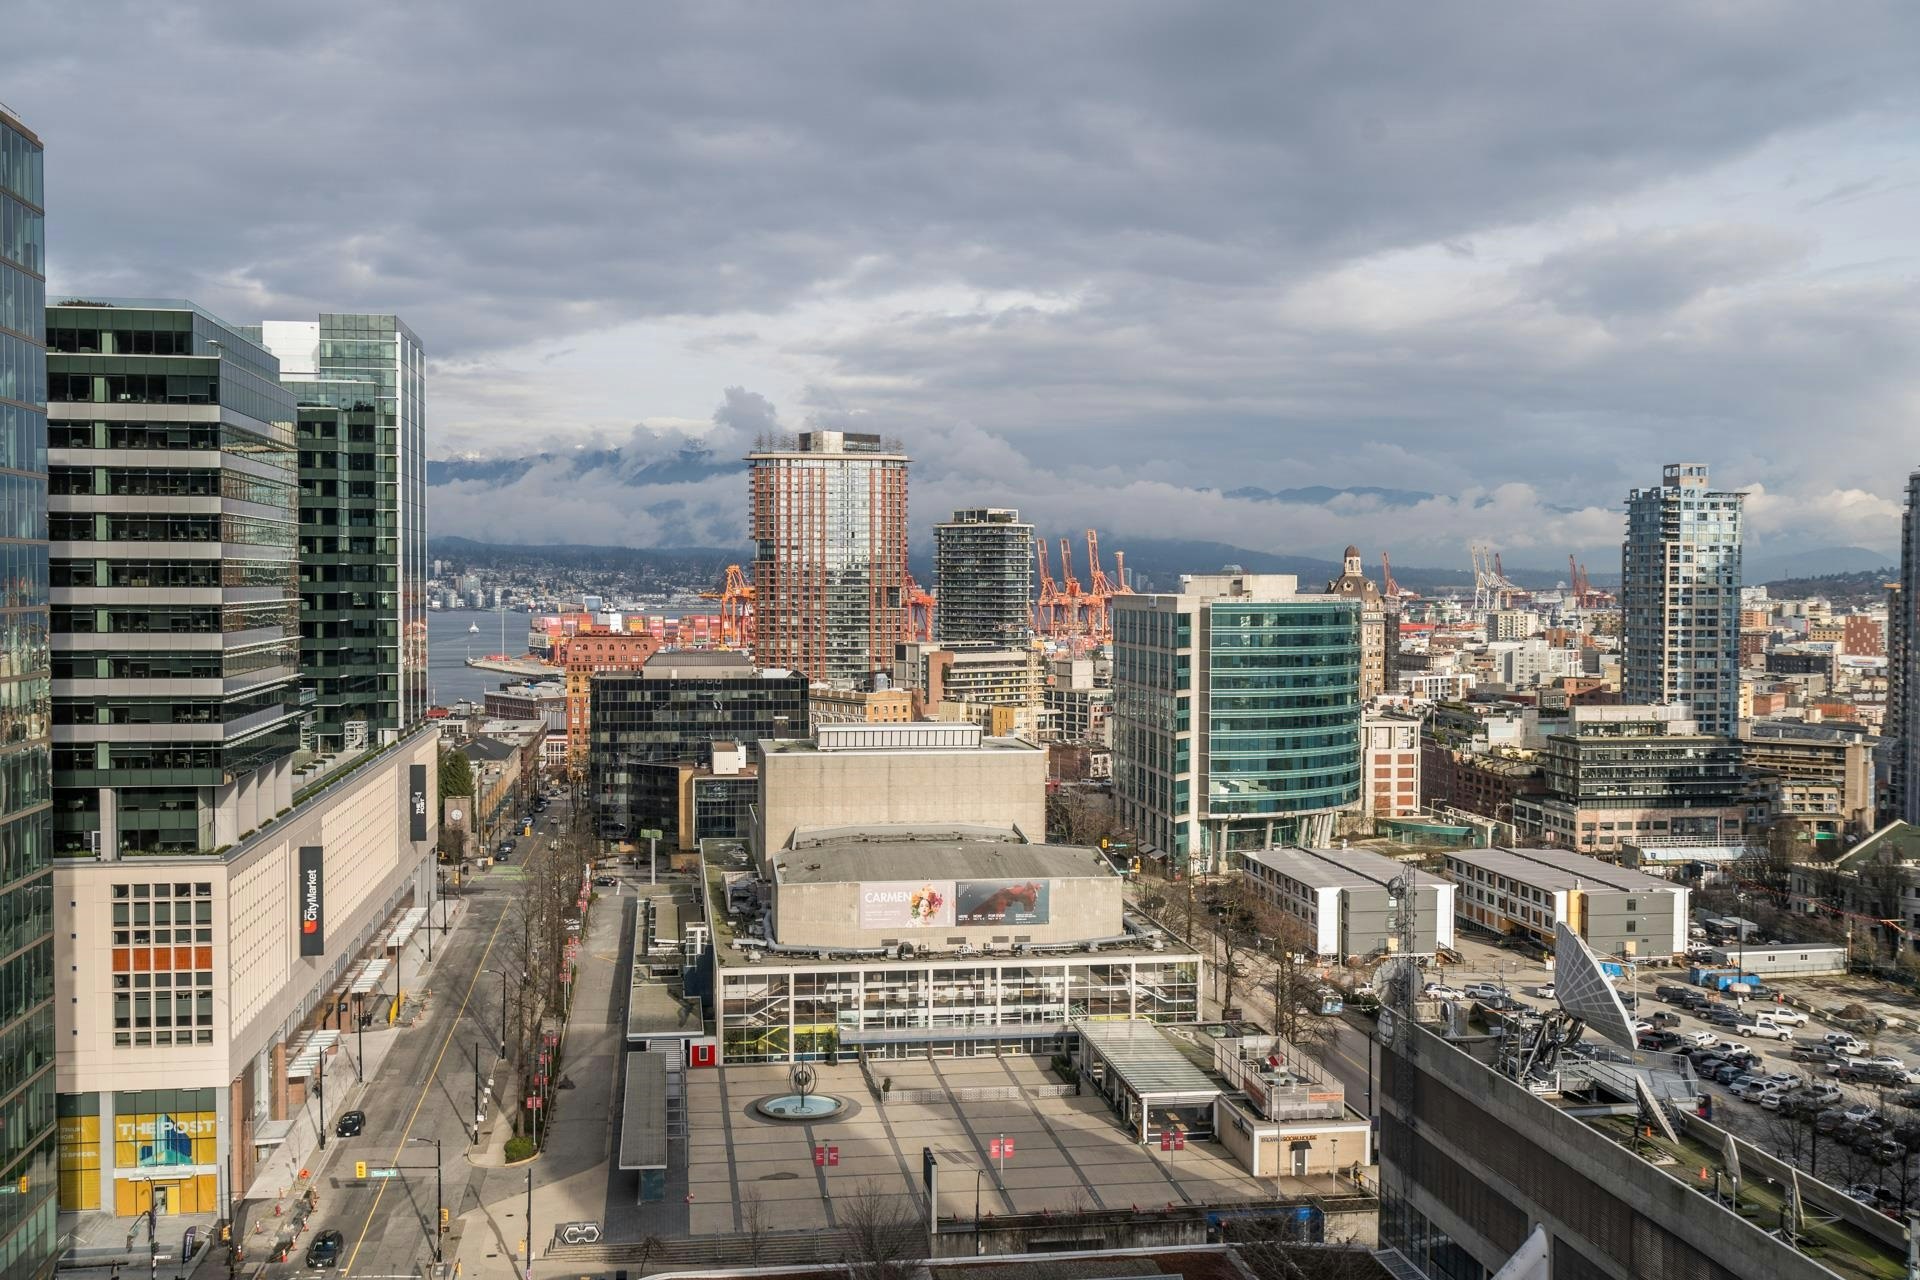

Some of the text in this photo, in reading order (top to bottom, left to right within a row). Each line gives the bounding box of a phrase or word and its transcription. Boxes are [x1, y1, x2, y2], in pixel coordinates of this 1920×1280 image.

[864, 891, 912, 904] CARMEN
[118, 1120, 216, 1136] THE POST
